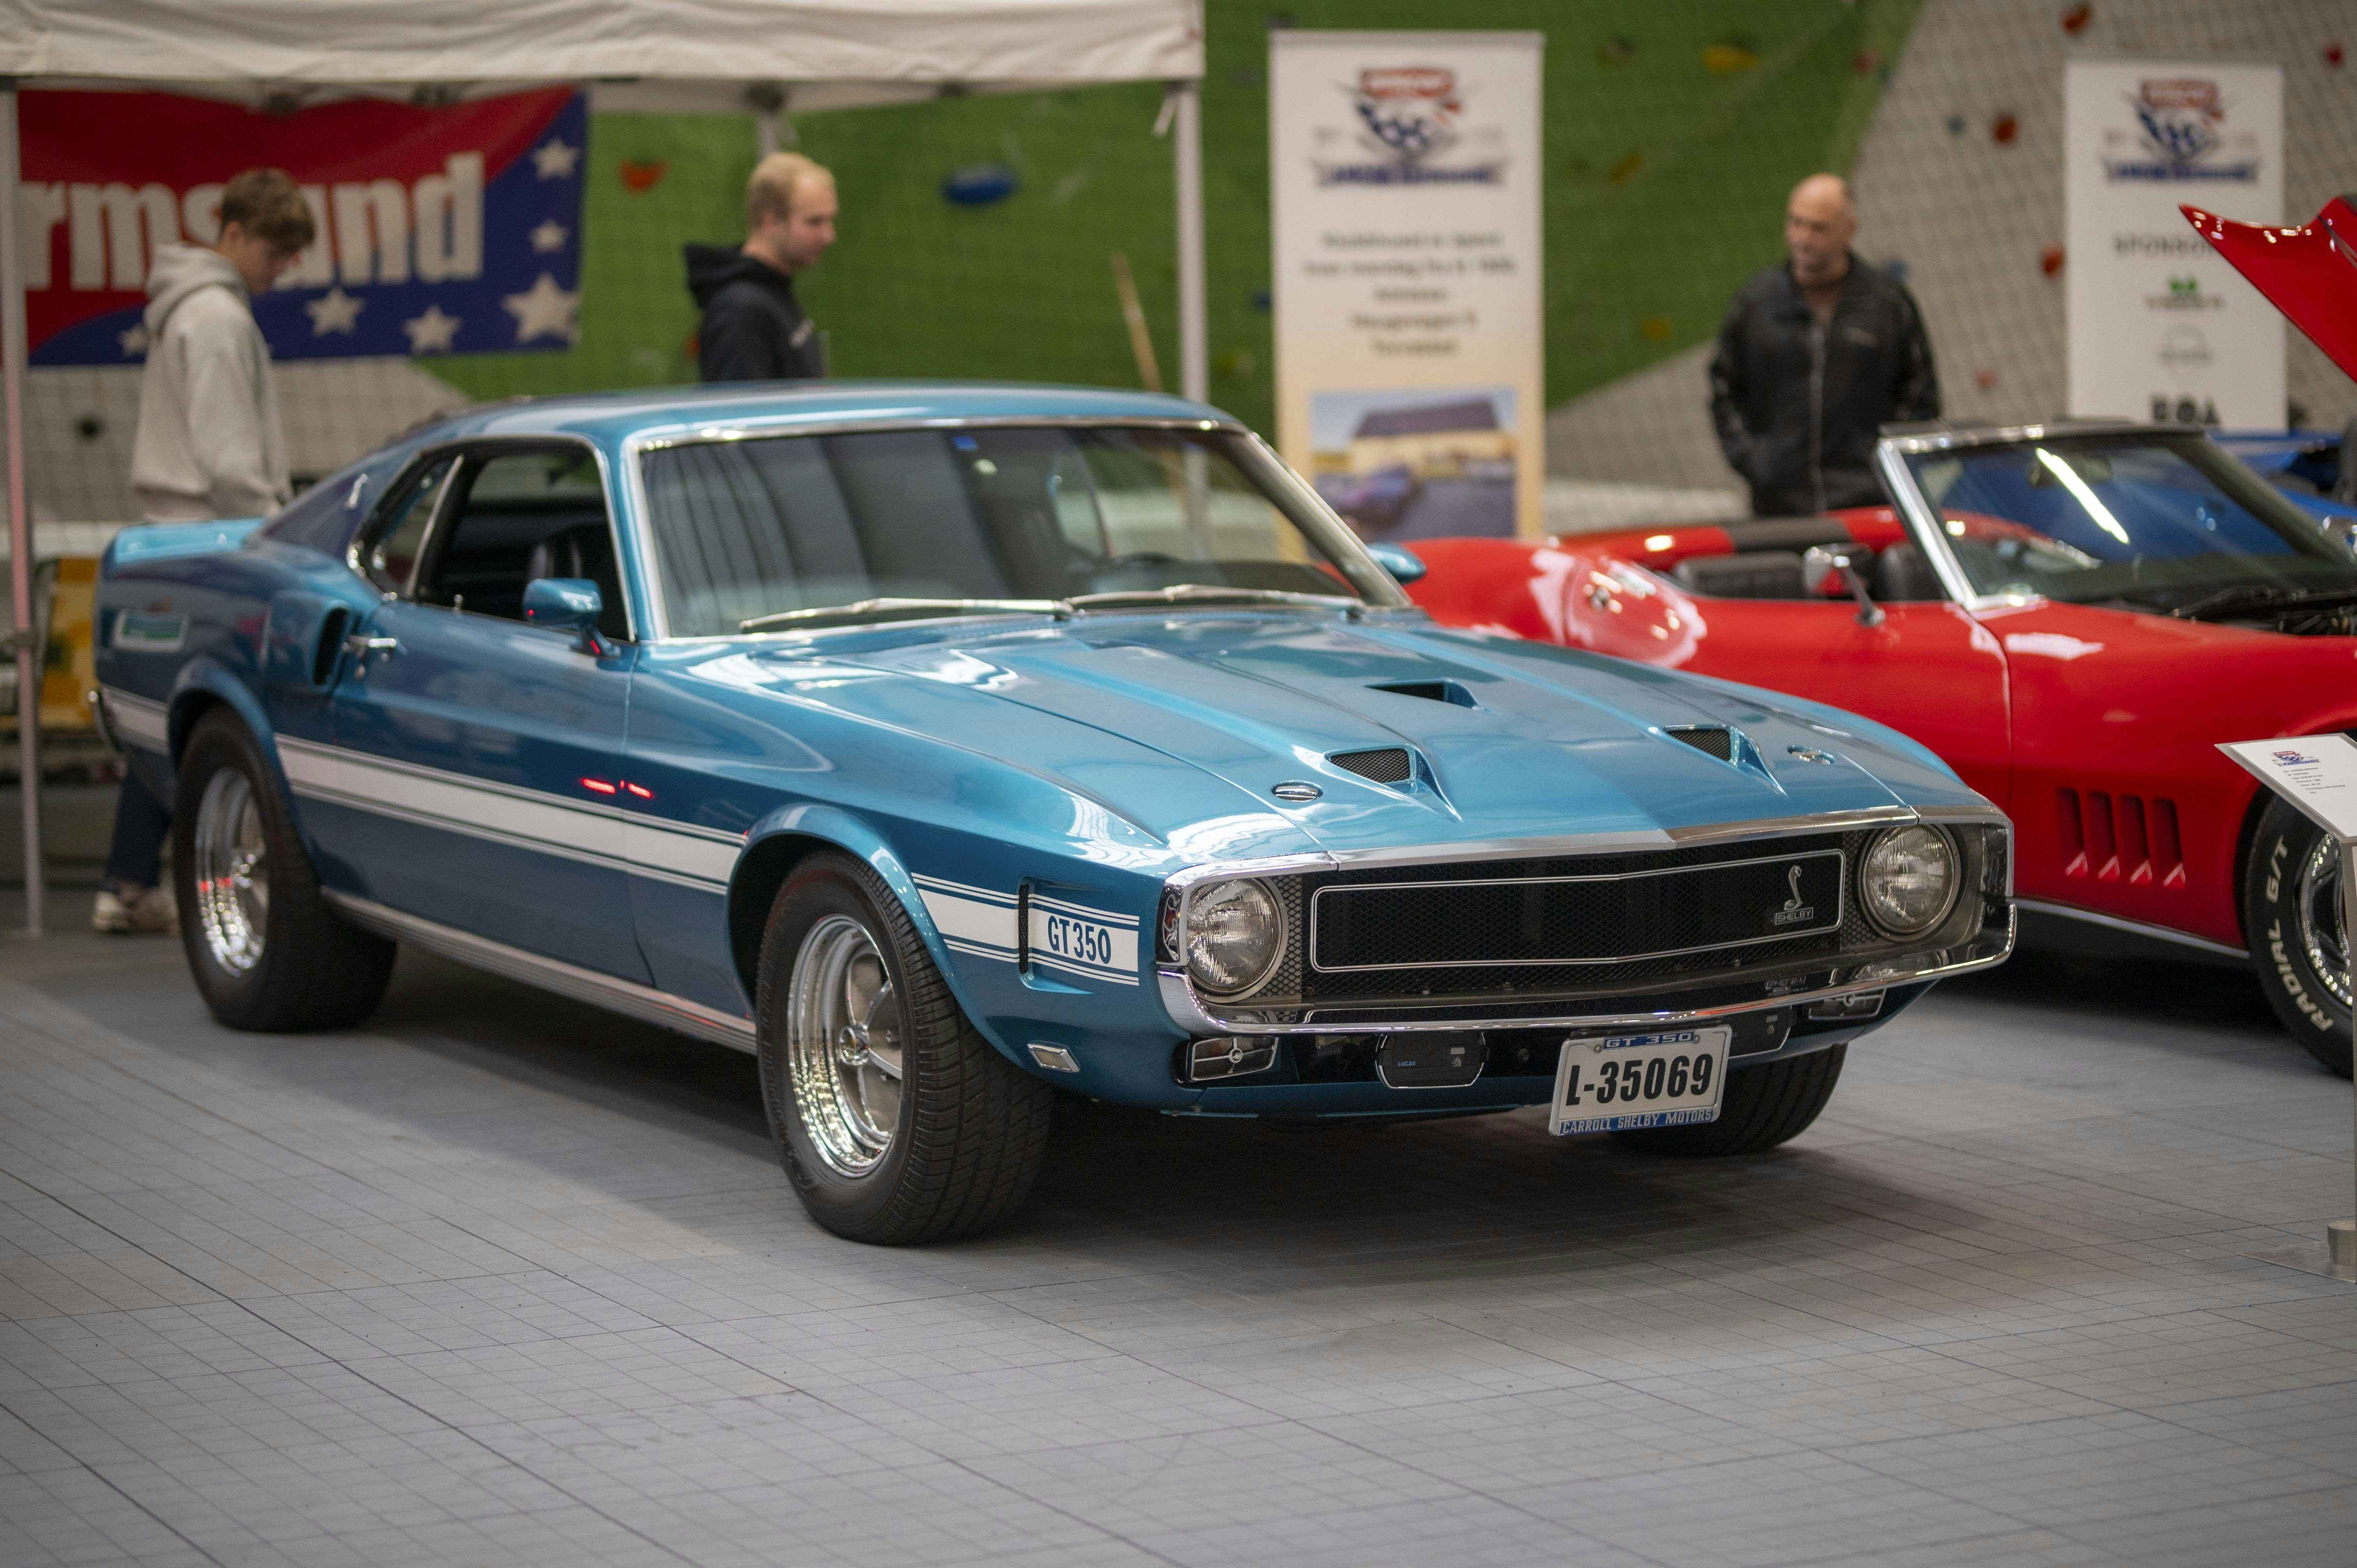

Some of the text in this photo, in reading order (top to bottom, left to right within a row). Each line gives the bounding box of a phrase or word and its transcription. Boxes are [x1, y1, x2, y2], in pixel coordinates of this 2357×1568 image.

[1777, 909, 1811, 922] SHELBY
[2267, 918, 2334, 1032] RADIAL
[1606, 1032, 1693, 1048] GT 350
[1565, 1053, 1714, 1106] L-35069
[1562, 1109, 1714, 1134] CARROLL SHELBY MOTORS
